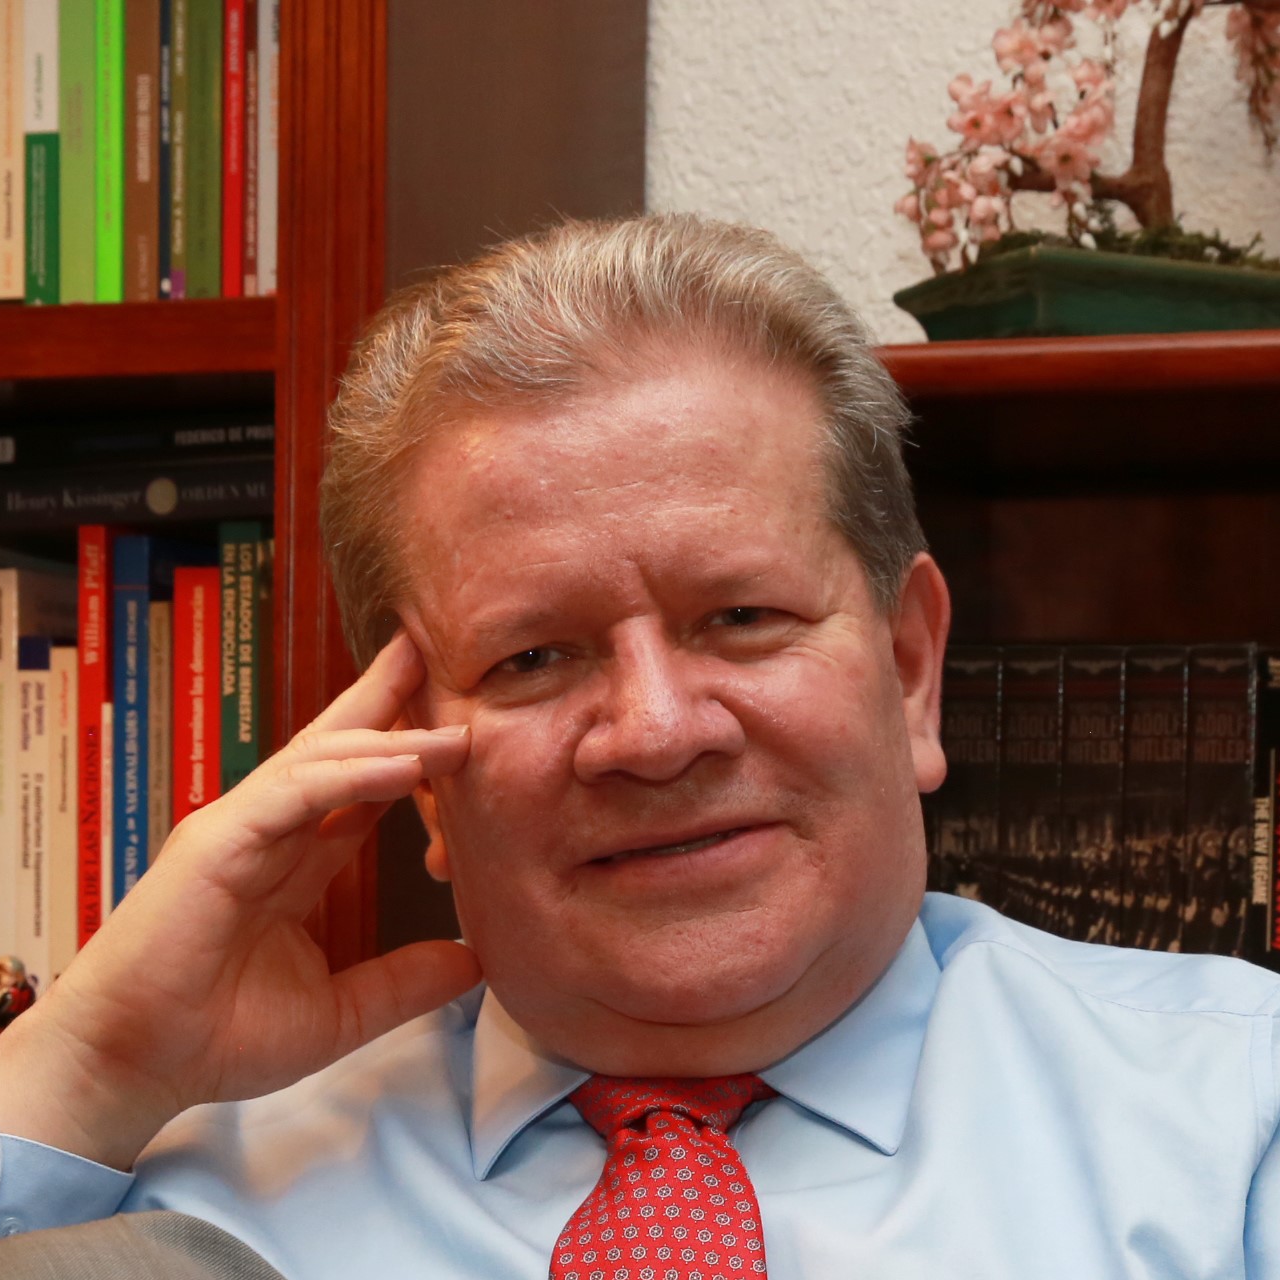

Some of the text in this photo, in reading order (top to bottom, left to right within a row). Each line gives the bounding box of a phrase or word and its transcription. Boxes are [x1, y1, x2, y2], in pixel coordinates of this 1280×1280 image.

[245, 424, 275, 441] PRUS
[6, 487, 58, 513] Henry
[61, 483, 142, 510] Kissinger
[82, 544, 101, 665] William Pfaff
[222, 543, 237, 697] EN LA ENCRUCIJADA
[238, 543, 253, 744] LOS ESTADOS DE BIENESTAR
[187, 585, 205, 804] Cómo terminan las democracias
[81, 726, 100, 830] NACIONES
[83, 834, 100, 866] LAS
[1252, 797, 1270, 905] THE NEW REGIME
